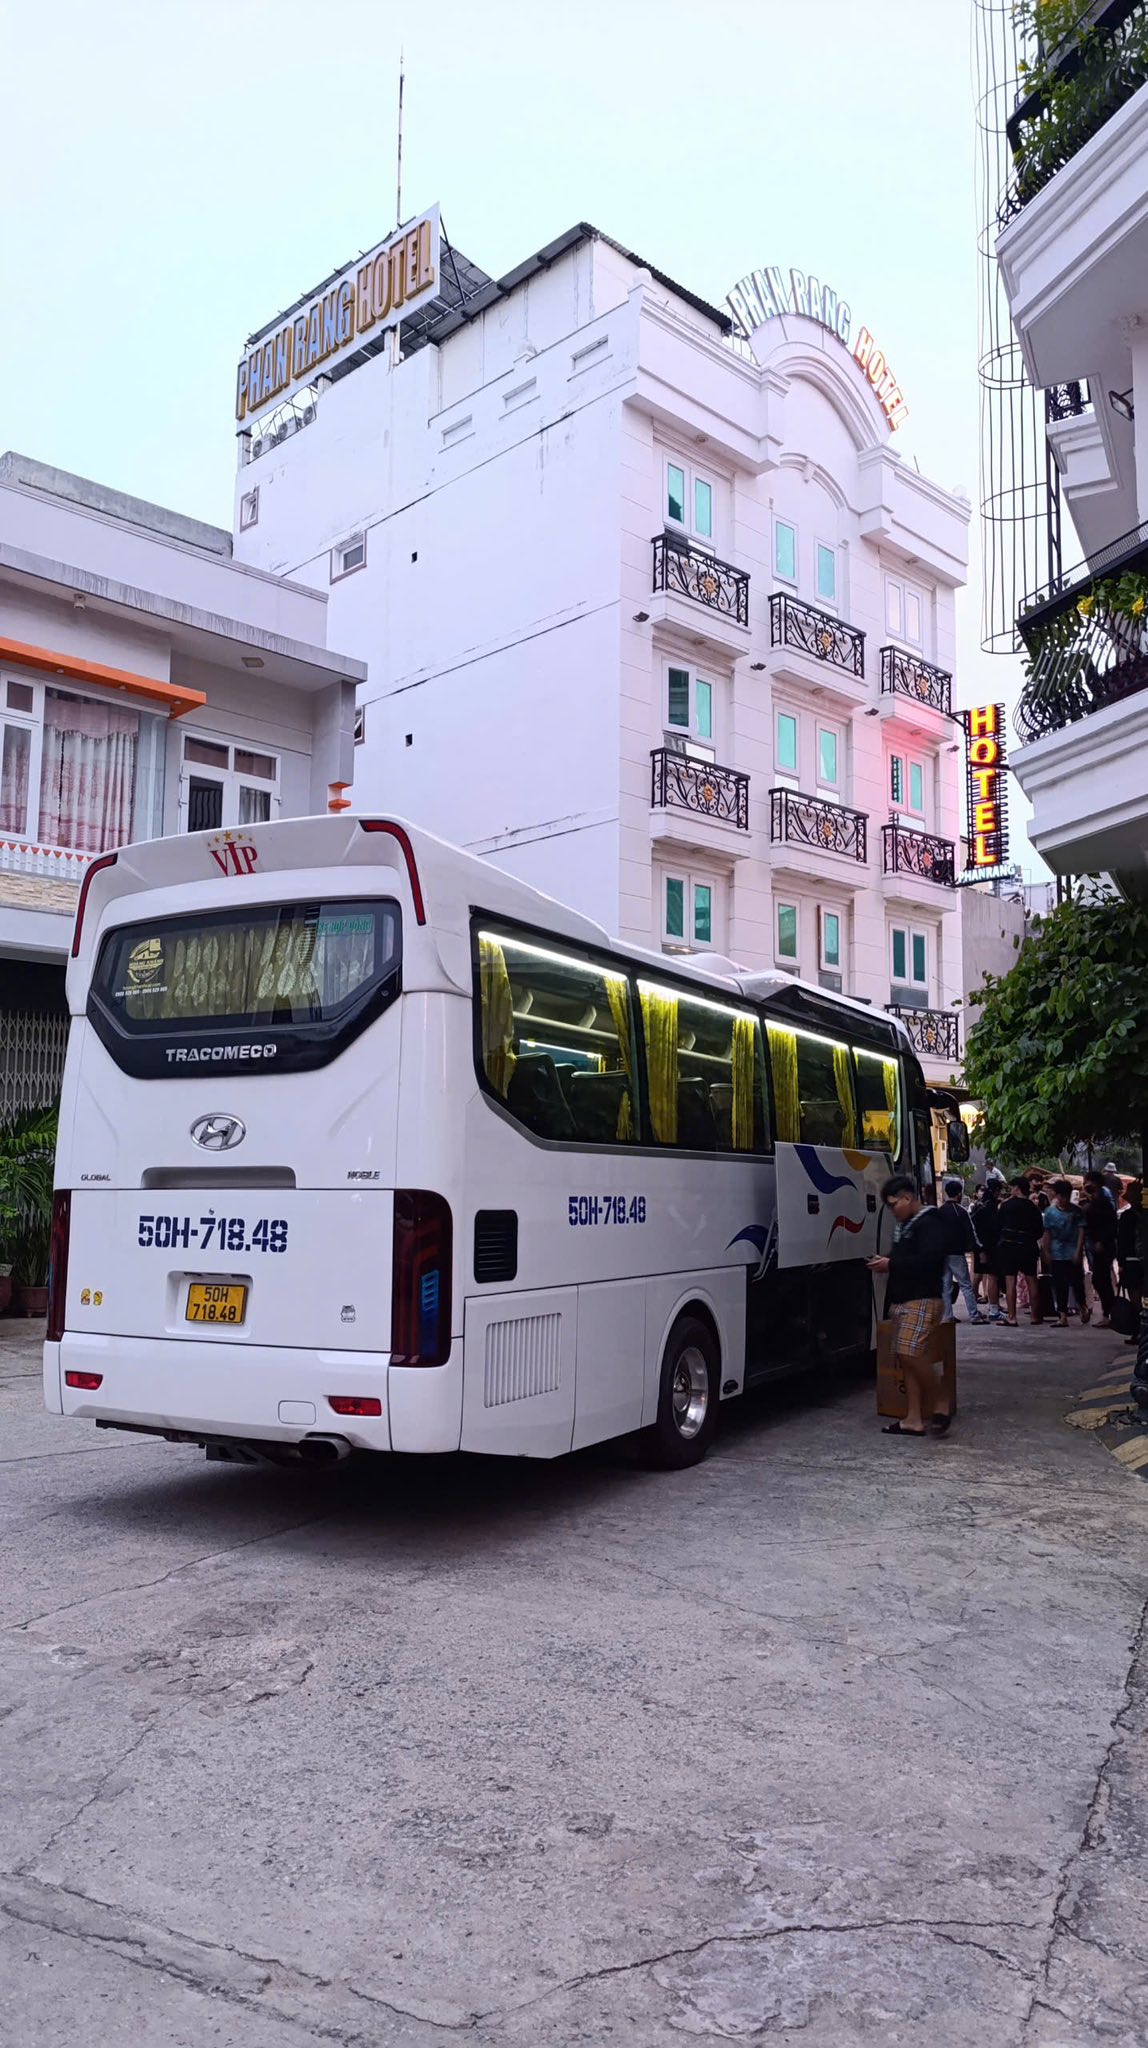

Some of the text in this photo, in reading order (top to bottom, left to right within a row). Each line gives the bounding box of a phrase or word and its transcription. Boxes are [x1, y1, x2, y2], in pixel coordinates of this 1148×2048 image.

[236, 219, 435, 421] PHAN RANG HOTEL
[726, 266, 909, 432] PHAN RANG HOTEL
[970, 703, 998, 865] HOTEL
[210, 842, 258, 876] VIP
[166, 1044, 277, 1062] TRACOMECO
[568, 1196, 646, 1226] 50H-718.48
[138, 1215, 288, 1253] 50H-718.48
[204, 1287, 229, 1302] 50H
[193, 1304, 236, 1321] 718.48
